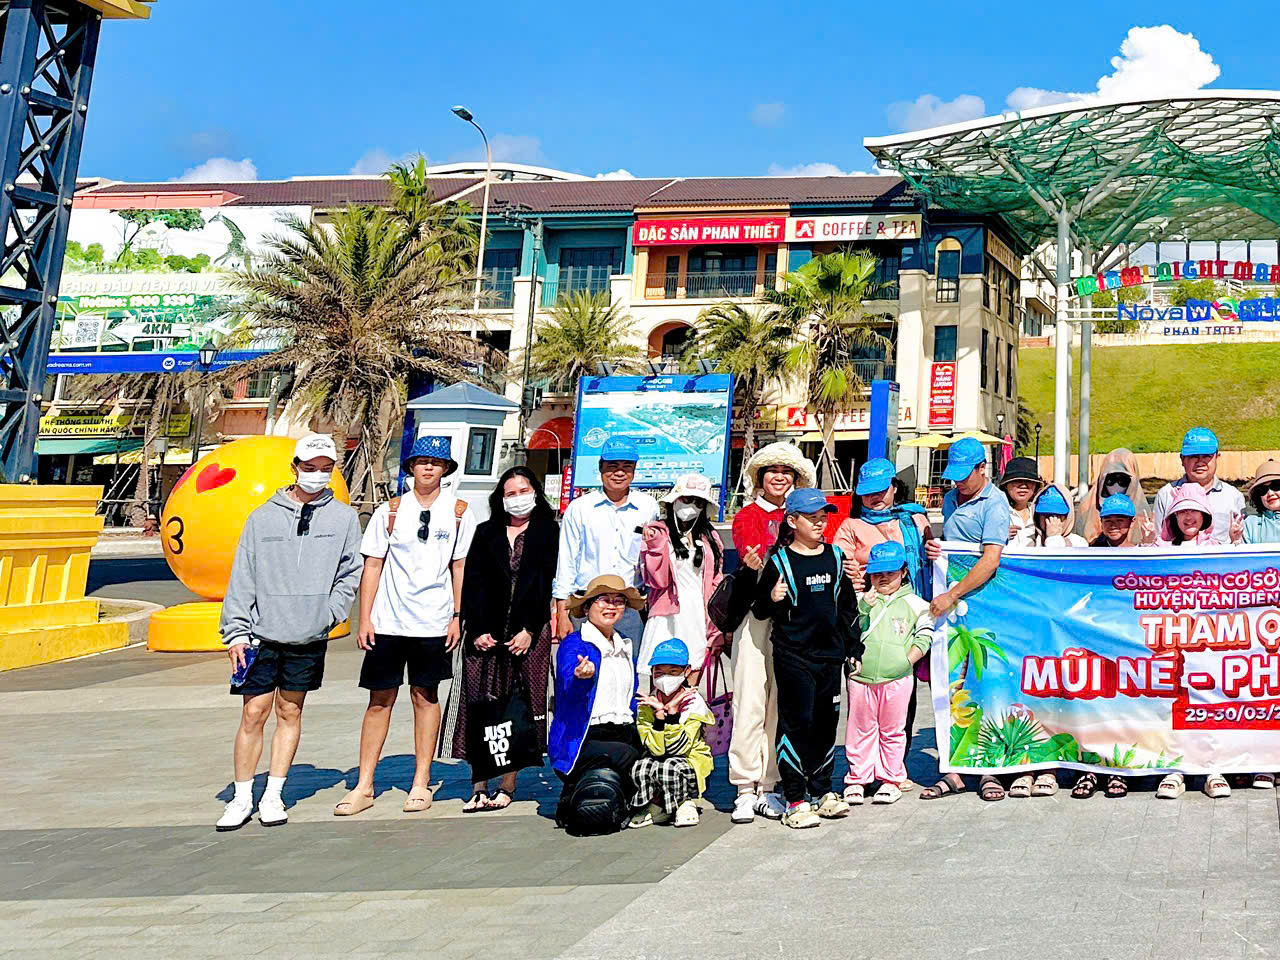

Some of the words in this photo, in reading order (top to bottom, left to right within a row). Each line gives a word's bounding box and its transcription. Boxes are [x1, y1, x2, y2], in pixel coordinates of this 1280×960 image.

[638, 225, 667, 244] ĐẶC
[670, 223, 699, 241] SẢN
[701, 225, 743, 240] PHAN
[744, 221, 781, 239] THIẾT
[822, 221, 872, 236] COFFEE
[876, 221, 885, 235] &
[892, 220, 917, 235] TEA
[1157, 259, 1229, 282] NIGHT
[141, 323, 173, 335] 4KM
[1163, 326, 1199, 336] PHAN
[1205, 325, 1244, 336] THIET
[1114, 573, 1163, 589] CÔNG
[1167, 572, 1218, 588] ĐOÀN
[1223, 571, 1250, 588] CƠ
[1252, 567, 1279, 587] SỞ
[1135, 590, 1199, 612] HUYỆN
[1199, 589, 1234, 607] TÂN
[1142, 613, 1246, 646] THAM
[1023, 649, 1101, 693] MŨI
[1117, 650, 1177, 691] NÉ
[483, 720, 513, 741] JUST
[488, 737, 510, 755] DO
[494, 752, 511, 767] IT.
